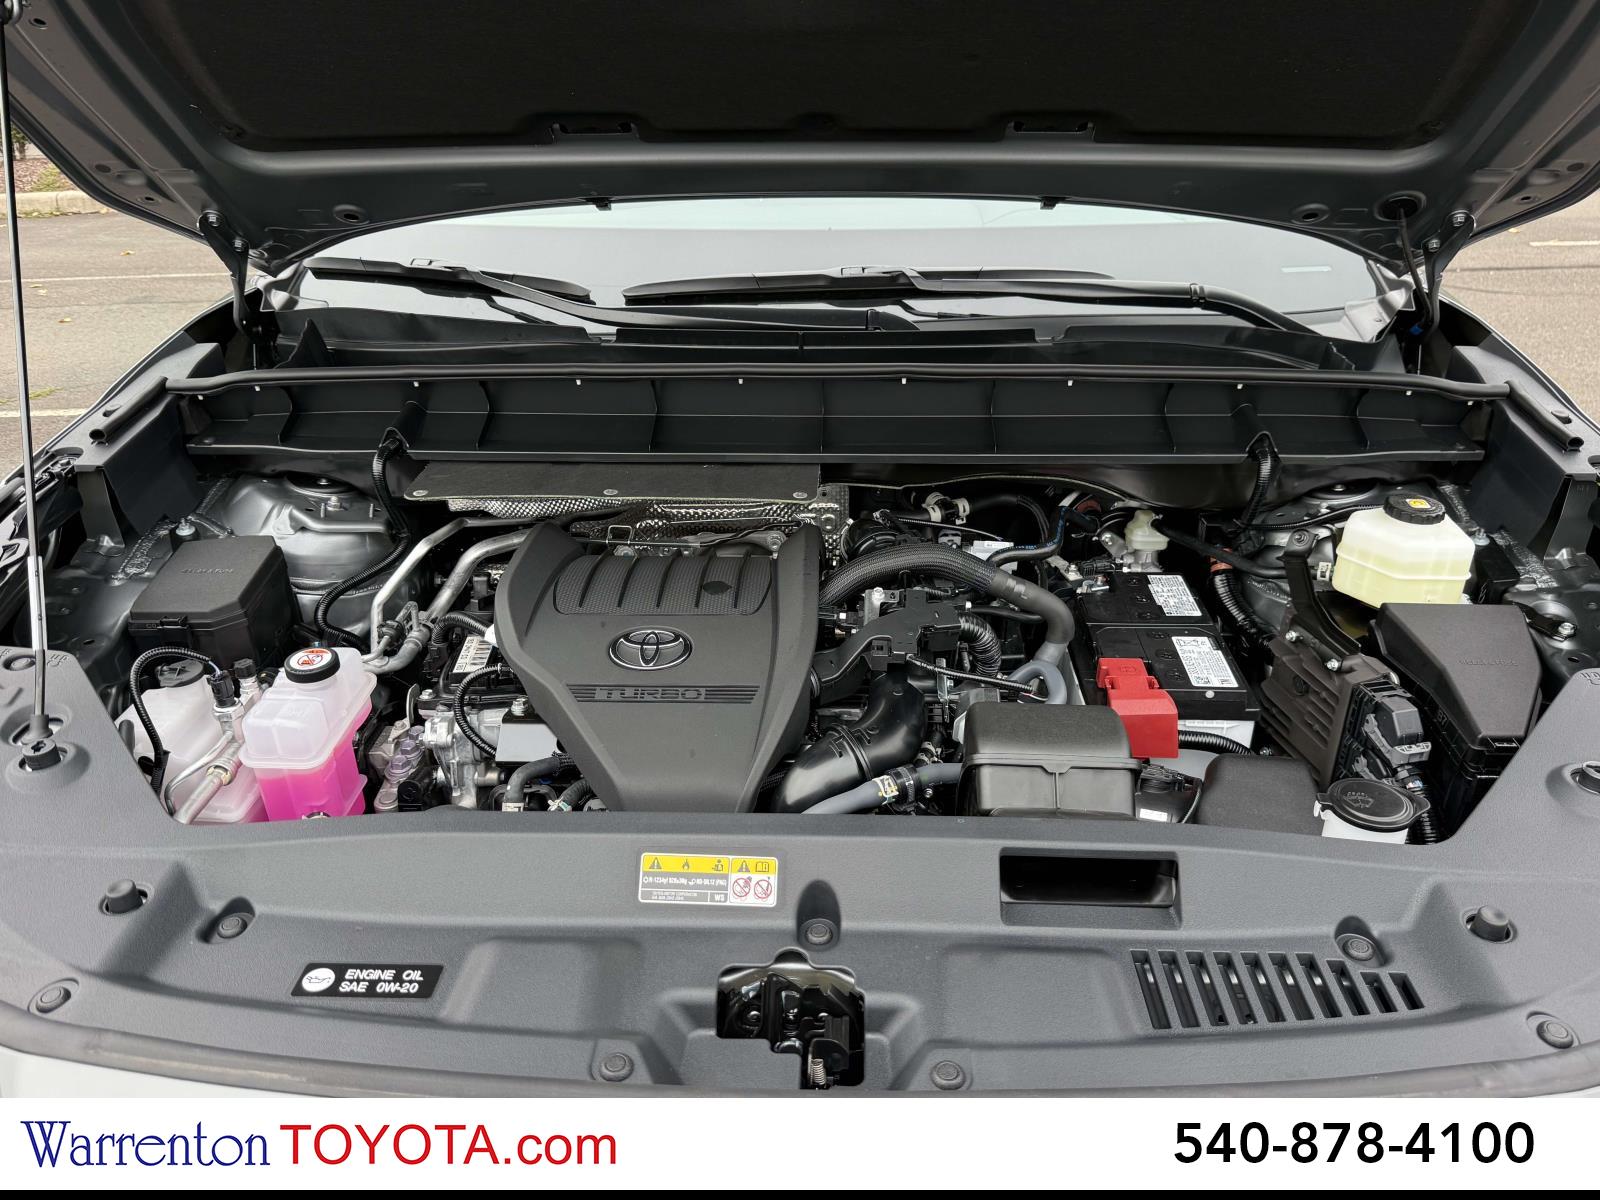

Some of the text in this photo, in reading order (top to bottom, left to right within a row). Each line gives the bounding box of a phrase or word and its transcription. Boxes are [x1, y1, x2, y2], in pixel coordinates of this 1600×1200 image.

[599, 688, 703, 700] TURBO
[344, 968, 424, 981] ENGINE OIL
[338, 981, 419, 994] SAE 0W-20
